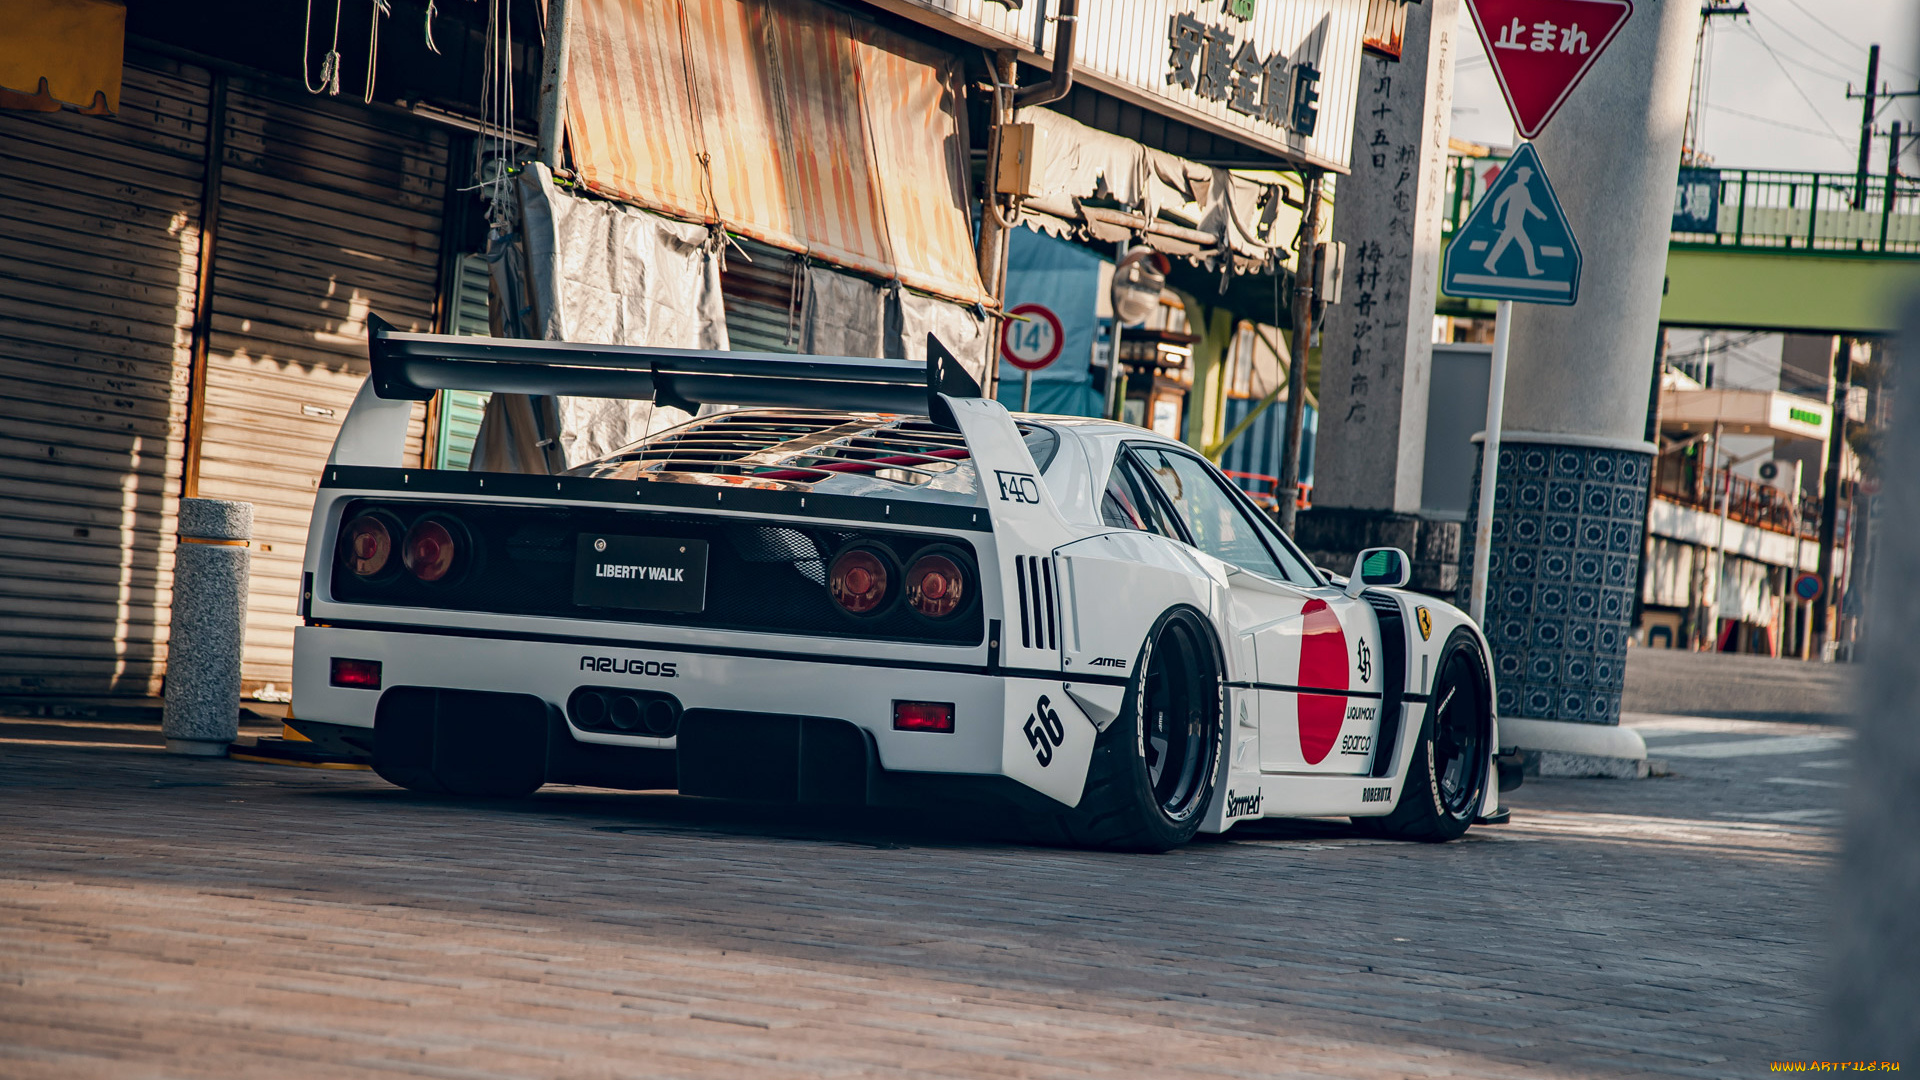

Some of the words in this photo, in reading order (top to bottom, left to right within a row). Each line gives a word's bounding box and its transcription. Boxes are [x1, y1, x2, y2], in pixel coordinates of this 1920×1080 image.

[1494, 17, 1591, 55] 止まれ
[993, 469, 1040, 505] F40
[595, 563, 648, 580] LIBERTY
[648, 567, 684, 582] WALK
[1088, 657, 1127, 668] AME
[1022, 694, 1065, 768] 56
[1341, 734, 1371, 755] sparco
